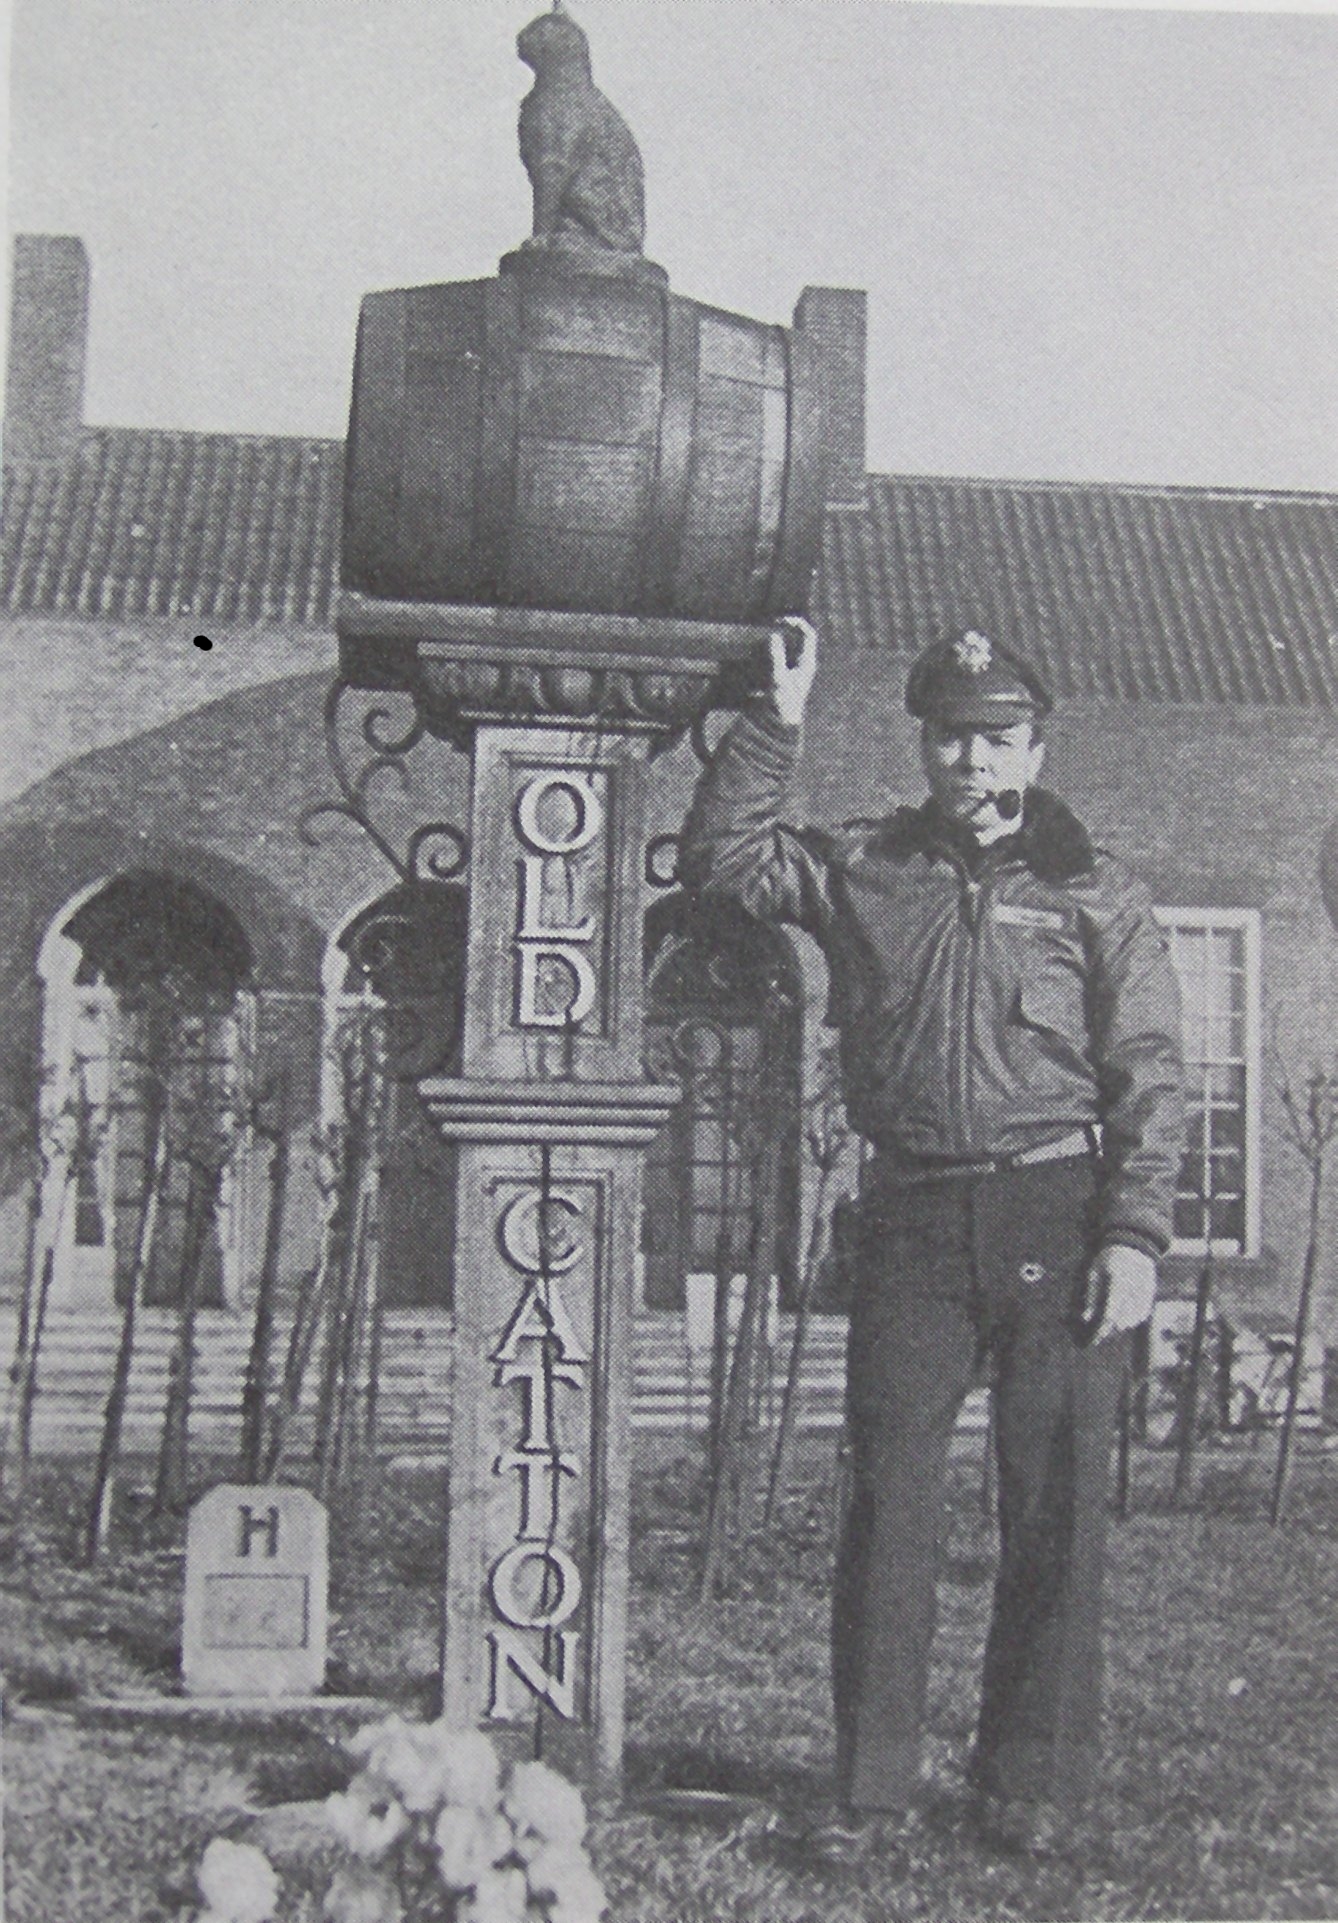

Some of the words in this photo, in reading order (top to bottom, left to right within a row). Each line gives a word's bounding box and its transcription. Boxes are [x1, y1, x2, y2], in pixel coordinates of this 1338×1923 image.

[516, 770, 603, 1026] OLD
[237, 1504, 280, 1557] H
[491, 1190, 587, 1719] CATTON
